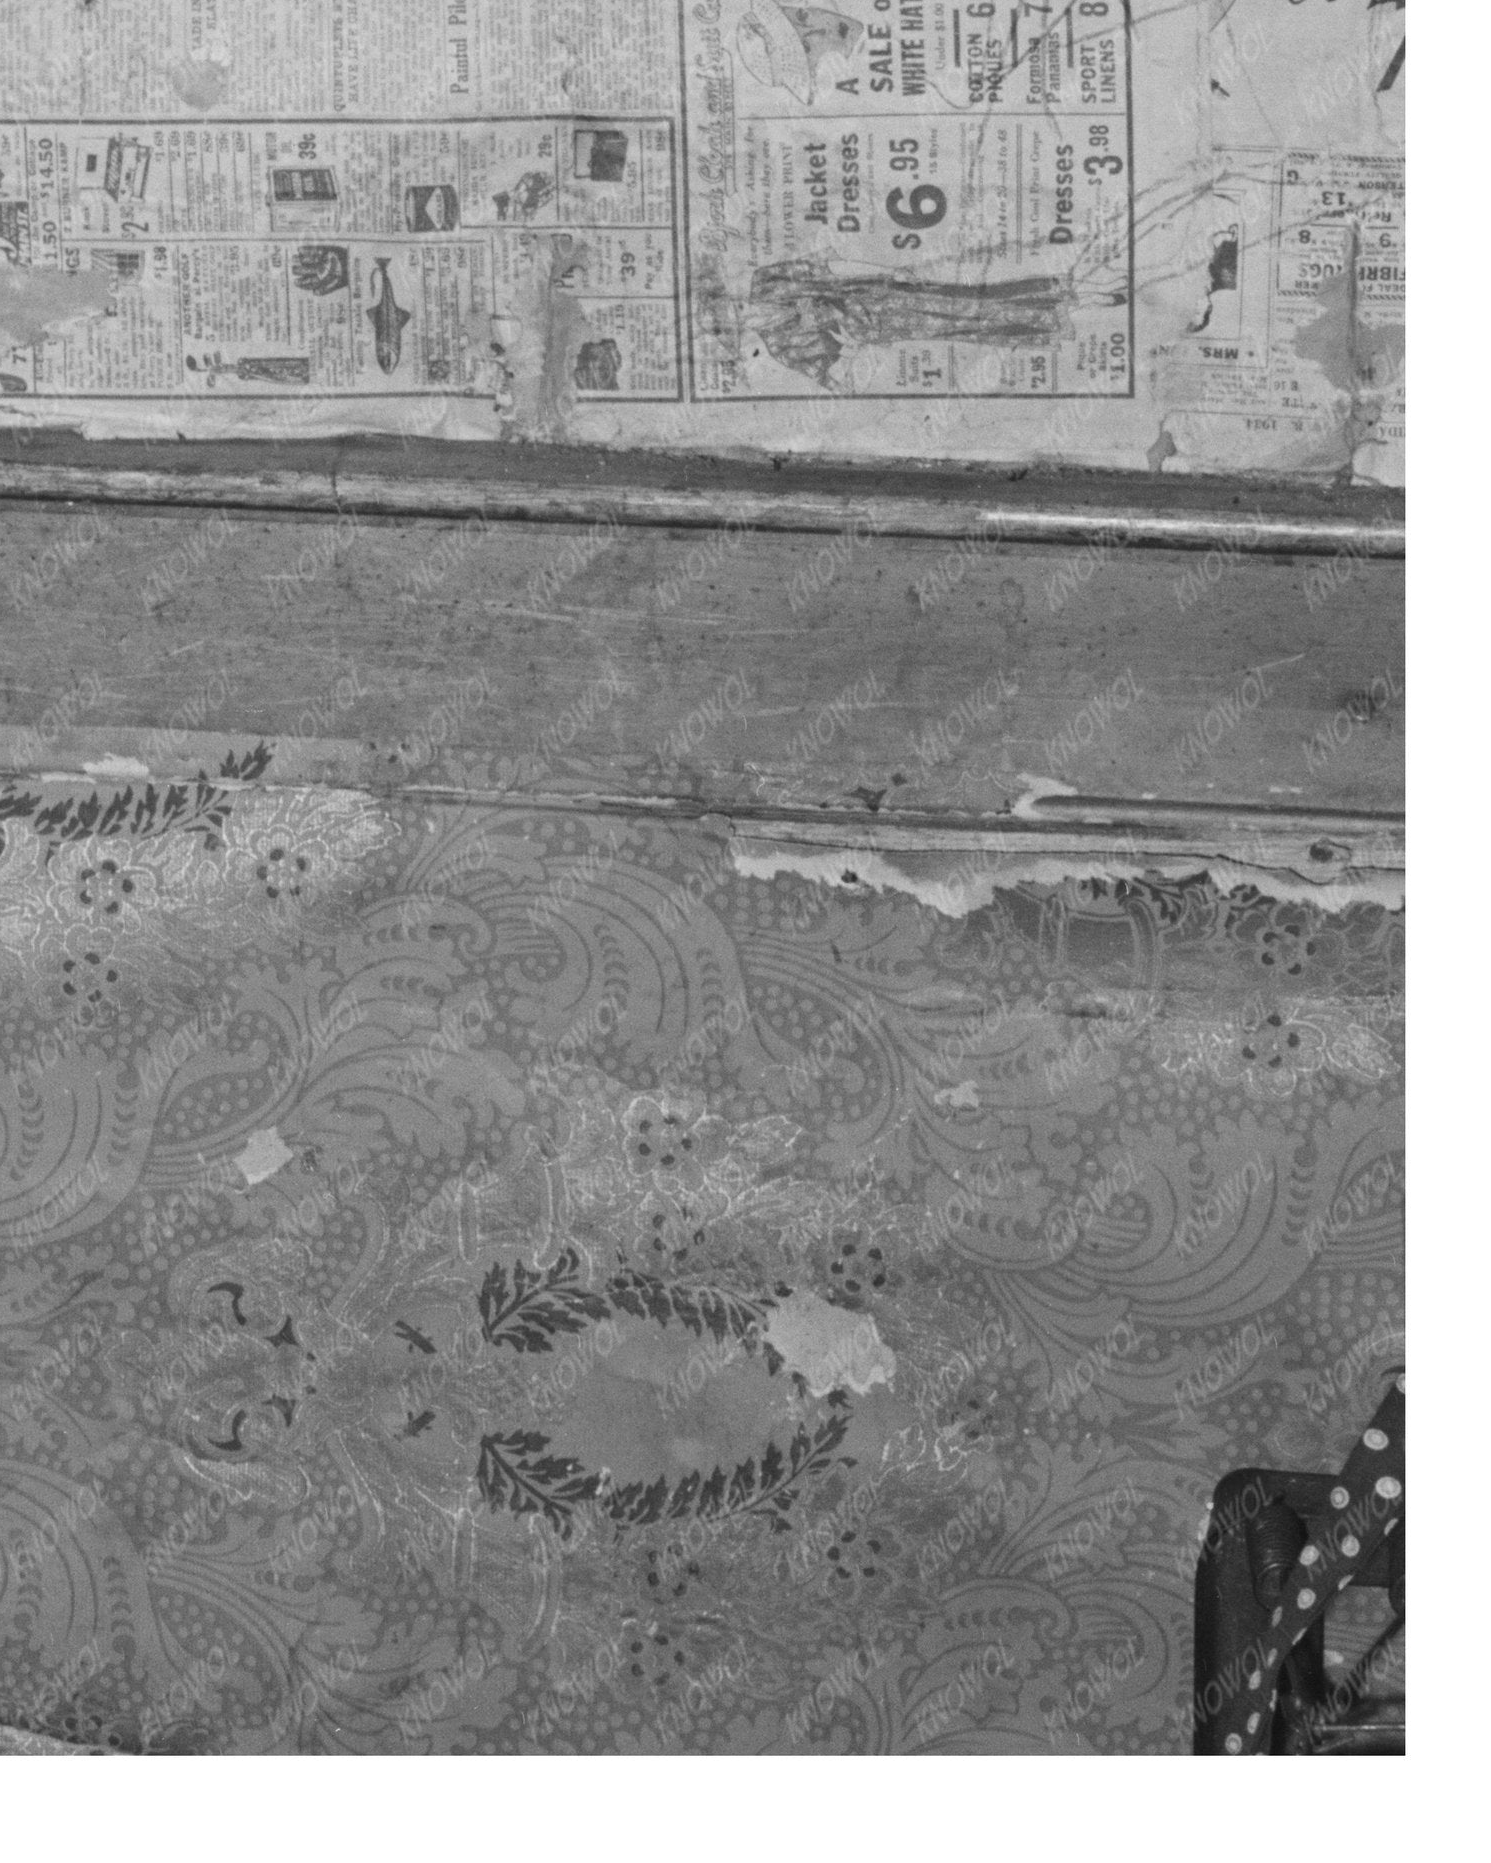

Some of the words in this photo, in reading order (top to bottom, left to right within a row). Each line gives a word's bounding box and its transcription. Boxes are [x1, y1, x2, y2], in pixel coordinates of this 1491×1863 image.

[447, 37, 470, 95] Painful
[867, 24, 895, 94] SALE
[899, 38, 926, 97] WHITE
[934, 35, 947, 71] Under
[965, 32, 985, 104] COTTON
[1025, 35, 1043, 105] Formosa
[1045, 31, 1062, 105] Panamas
[1079, 43, 1099, 105] SPORT
[1098, 38, 1117, 105] LINENS
[836, 77, 860, 95] A
[781, 144, 795, 185] PRINT
[802, 142, 830, 226] Jacket
[836, 132, 861, 234] Dresses
[1082, 124, 1124, 187] $3.98
[884, 138, 948, 251] $6.95
[1048, 143, 1074, 246] Dresses
[1110, 332, 1126, 382] $1.00
[1197, 345, 1240, 361] MRS.
